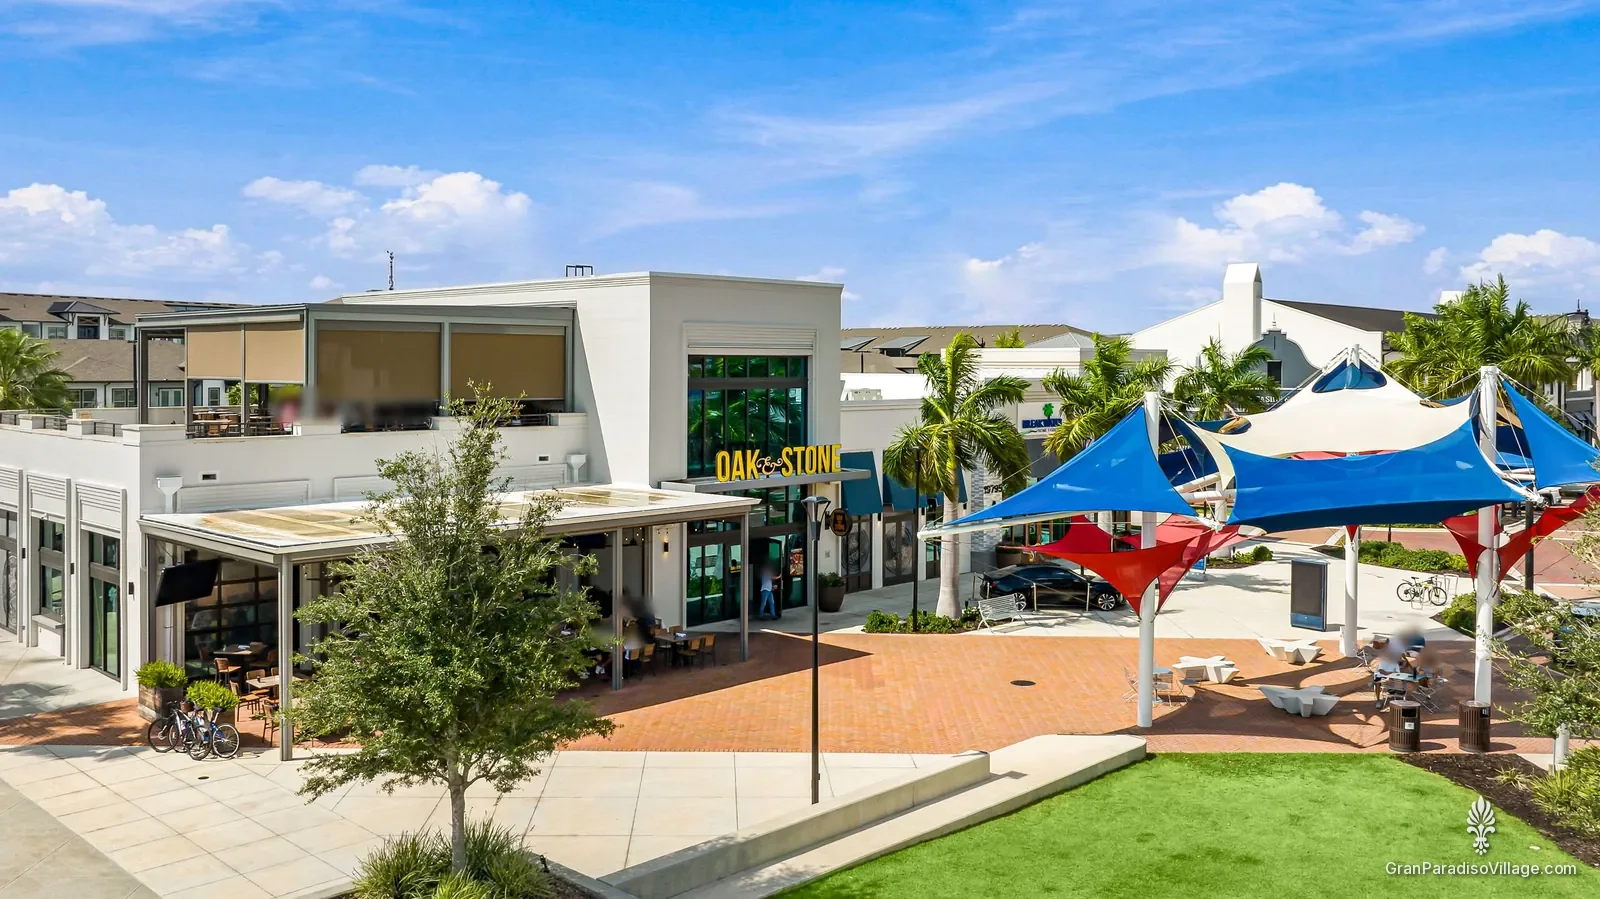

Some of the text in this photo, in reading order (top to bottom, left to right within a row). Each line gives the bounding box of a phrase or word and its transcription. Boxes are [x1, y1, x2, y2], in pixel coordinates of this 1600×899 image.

[716, 444, 842, 482] OAK & STONE
